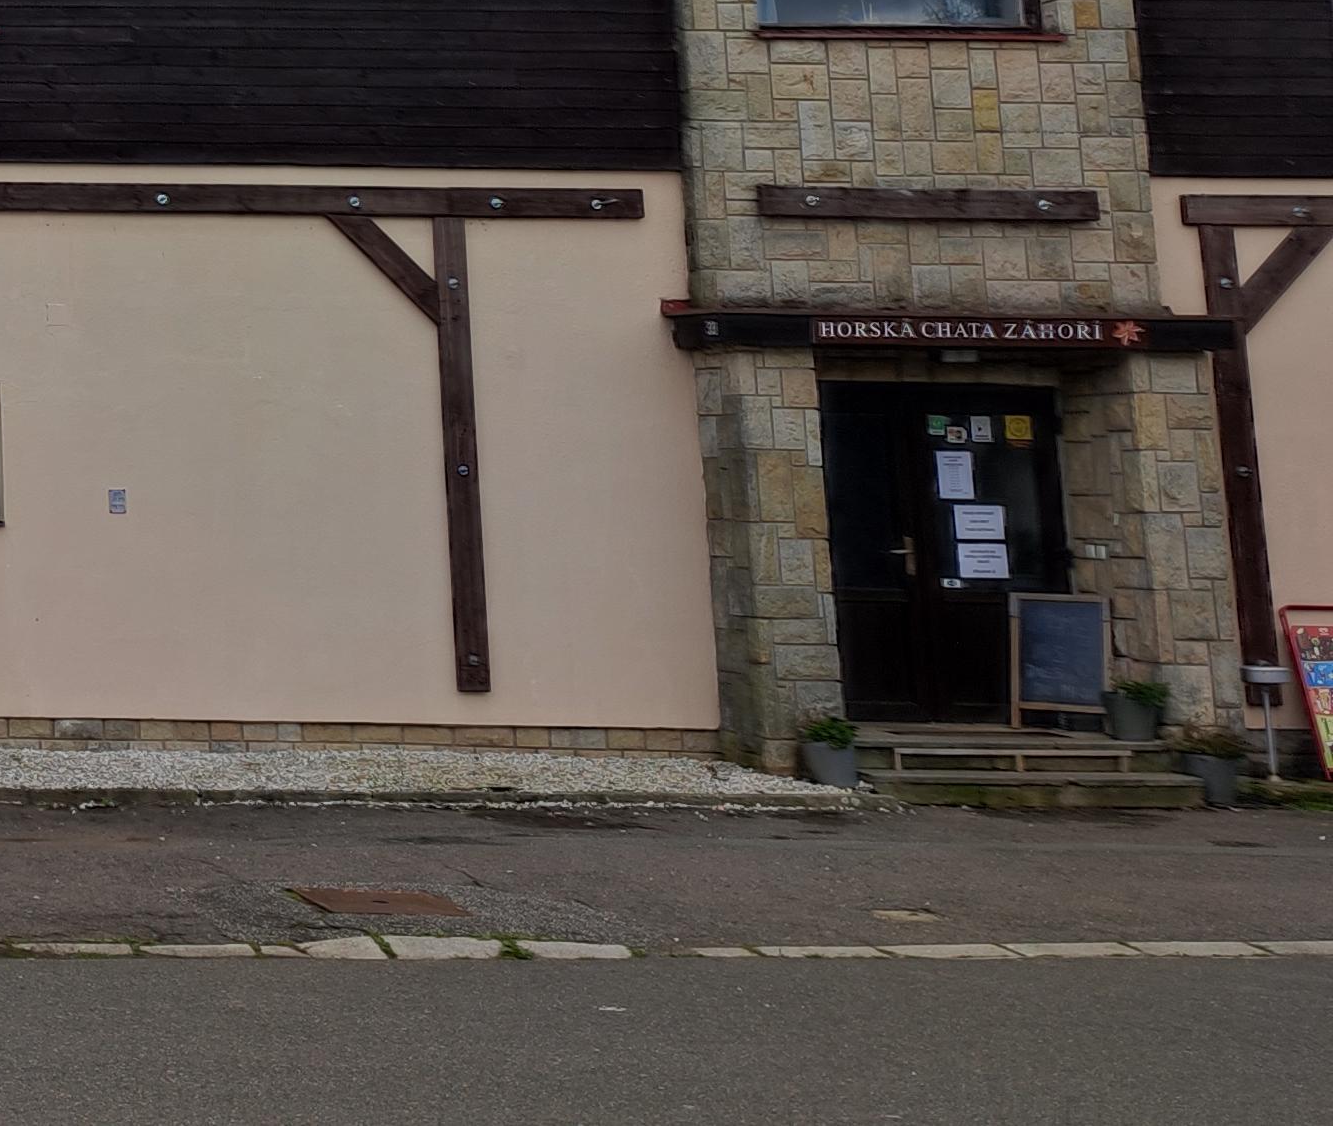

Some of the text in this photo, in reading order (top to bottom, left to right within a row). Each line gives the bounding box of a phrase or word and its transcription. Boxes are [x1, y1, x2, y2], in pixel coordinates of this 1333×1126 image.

[820, 318, 1102, 340] HORSKÁ CHATA ZÁHOŘÍ
